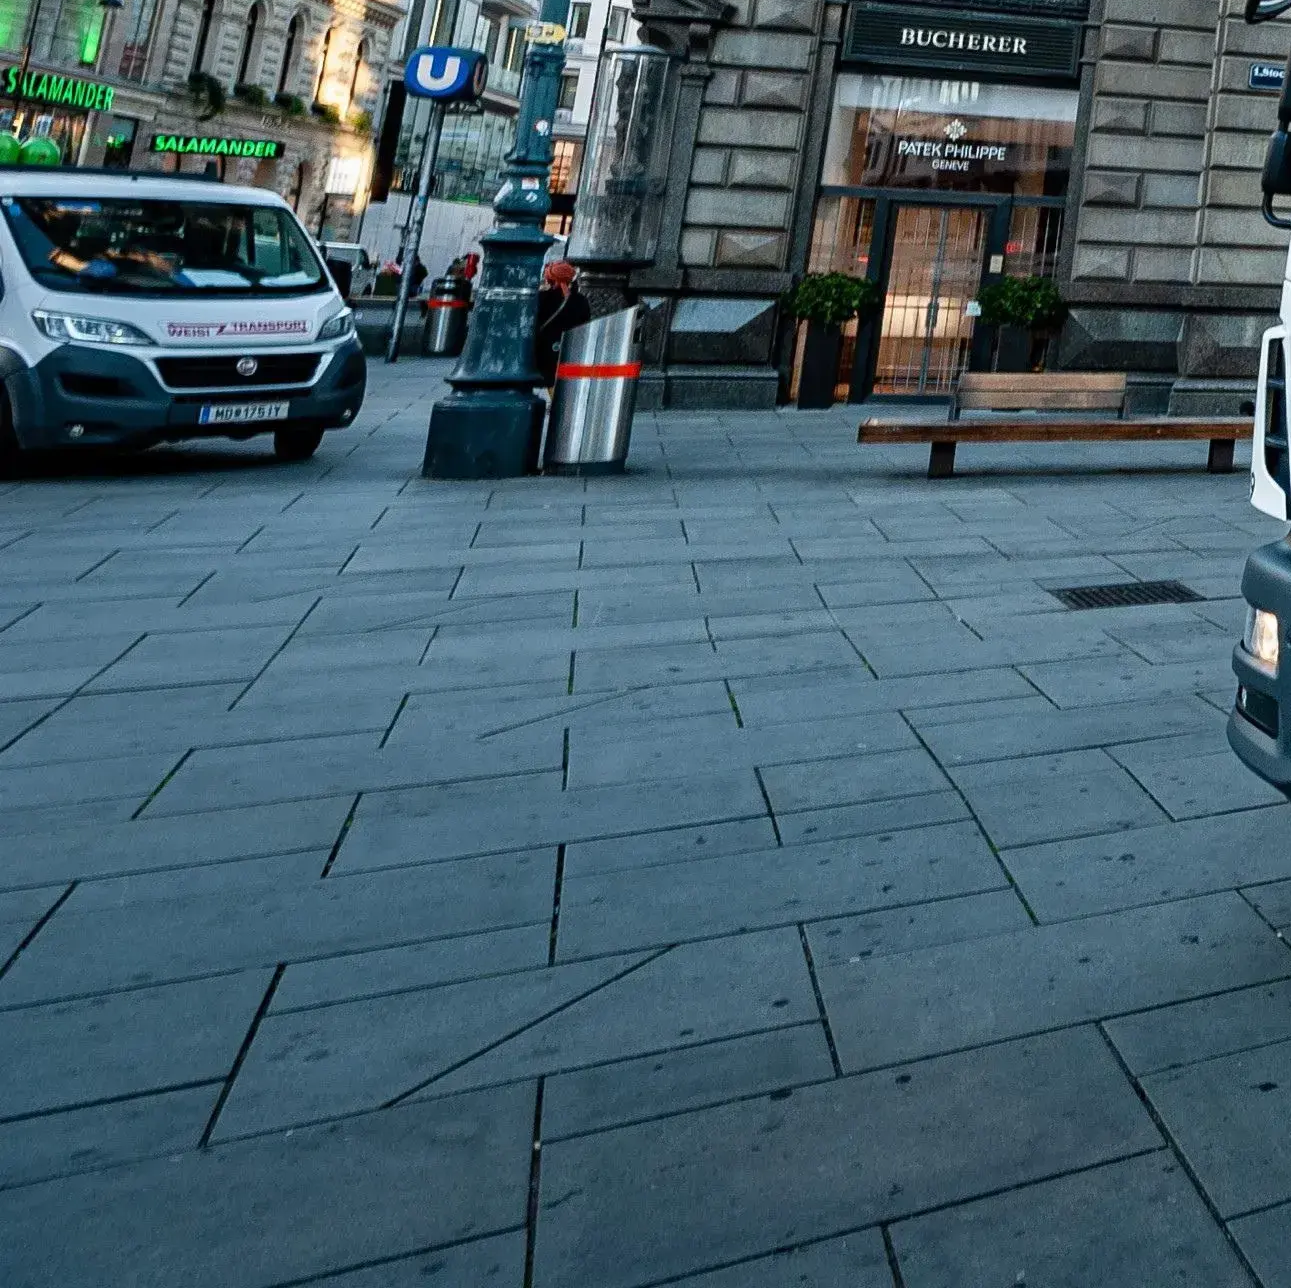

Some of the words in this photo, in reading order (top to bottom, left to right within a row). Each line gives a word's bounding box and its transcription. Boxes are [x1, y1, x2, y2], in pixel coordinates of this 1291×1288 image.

[900, 27, 1027, 55] BUCHERER
[417, 54, 461, 91] U
[6, 65, 115, 111] SALAMANDER
[155, 135, 277, 158] SALAMANDER
[898, 140, 942, 157] PATEK
[944, 143, 1006, 161] PHILIPPE
[931, 159, 969, 171] GENEVE
